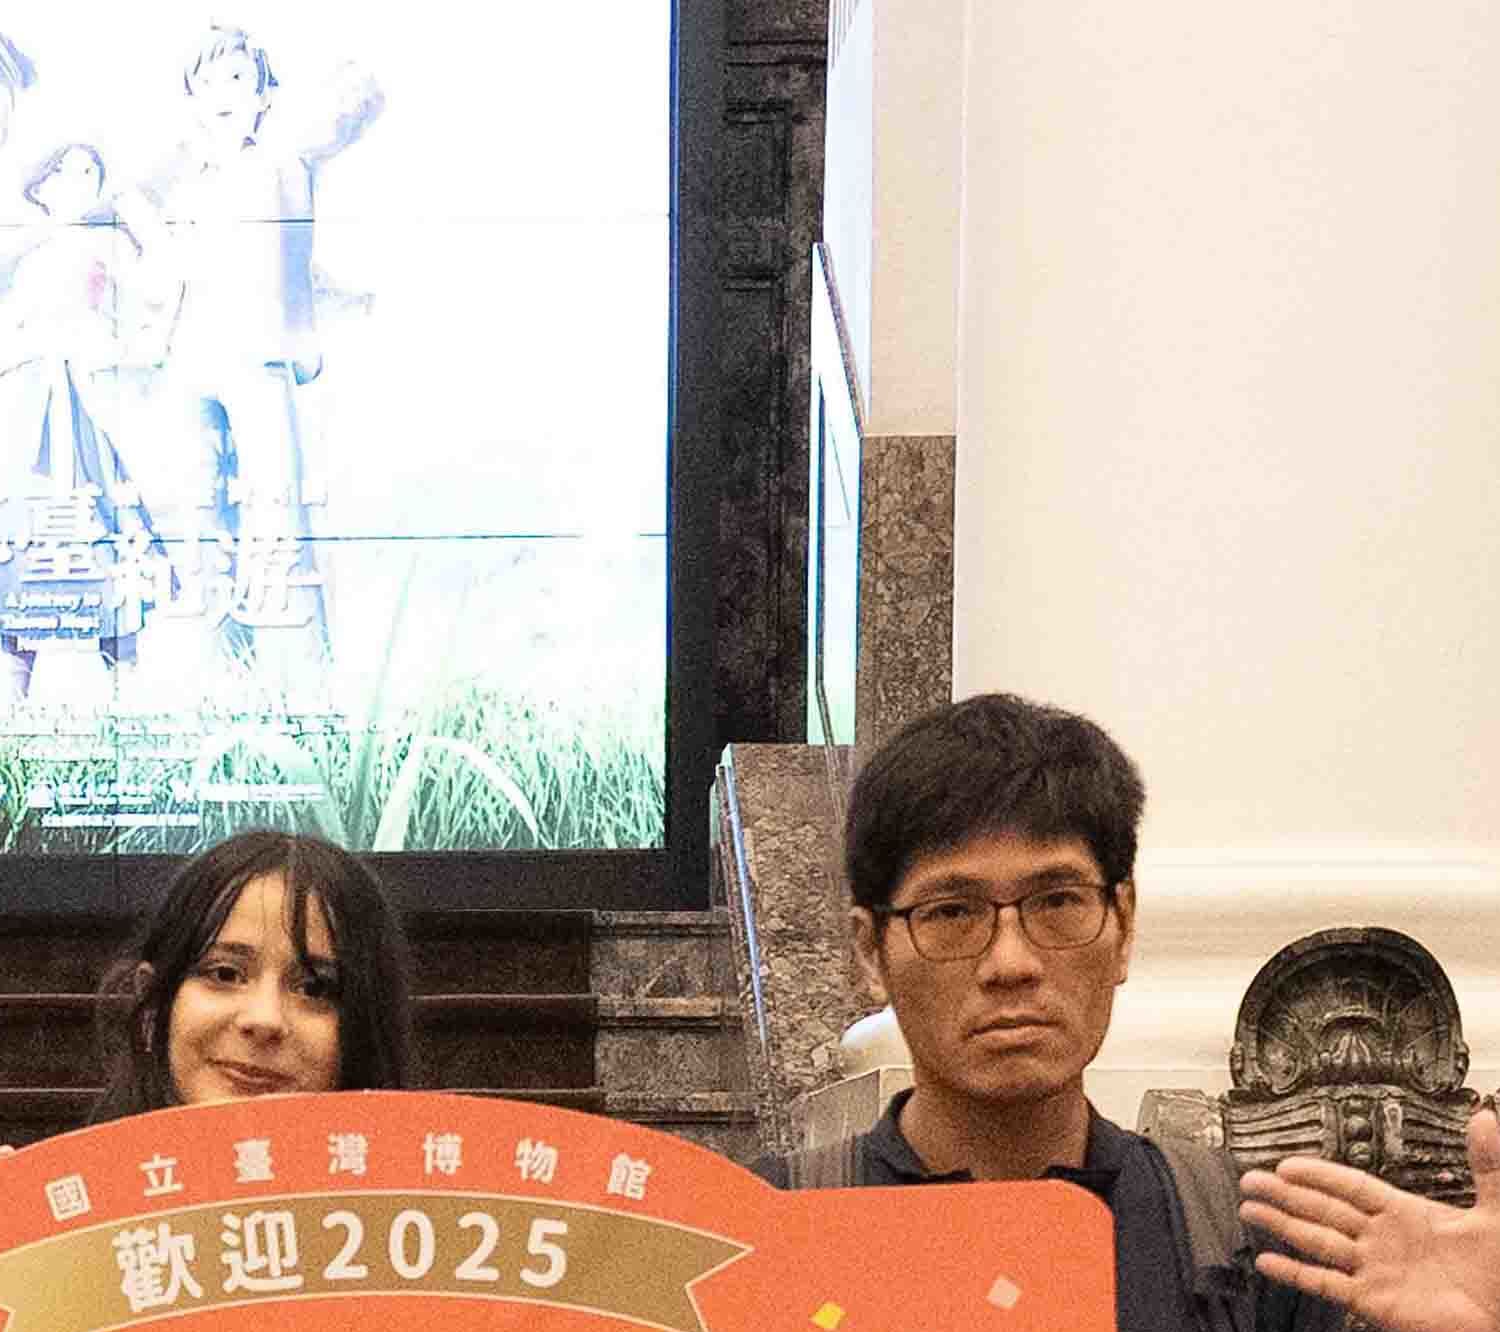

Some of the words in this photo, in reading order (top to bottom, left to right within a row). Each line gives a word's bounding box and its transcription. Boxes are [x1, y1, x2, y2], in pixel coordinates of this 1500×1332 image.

[44, 1133, 653, 1222] 國立臺灣博物館
